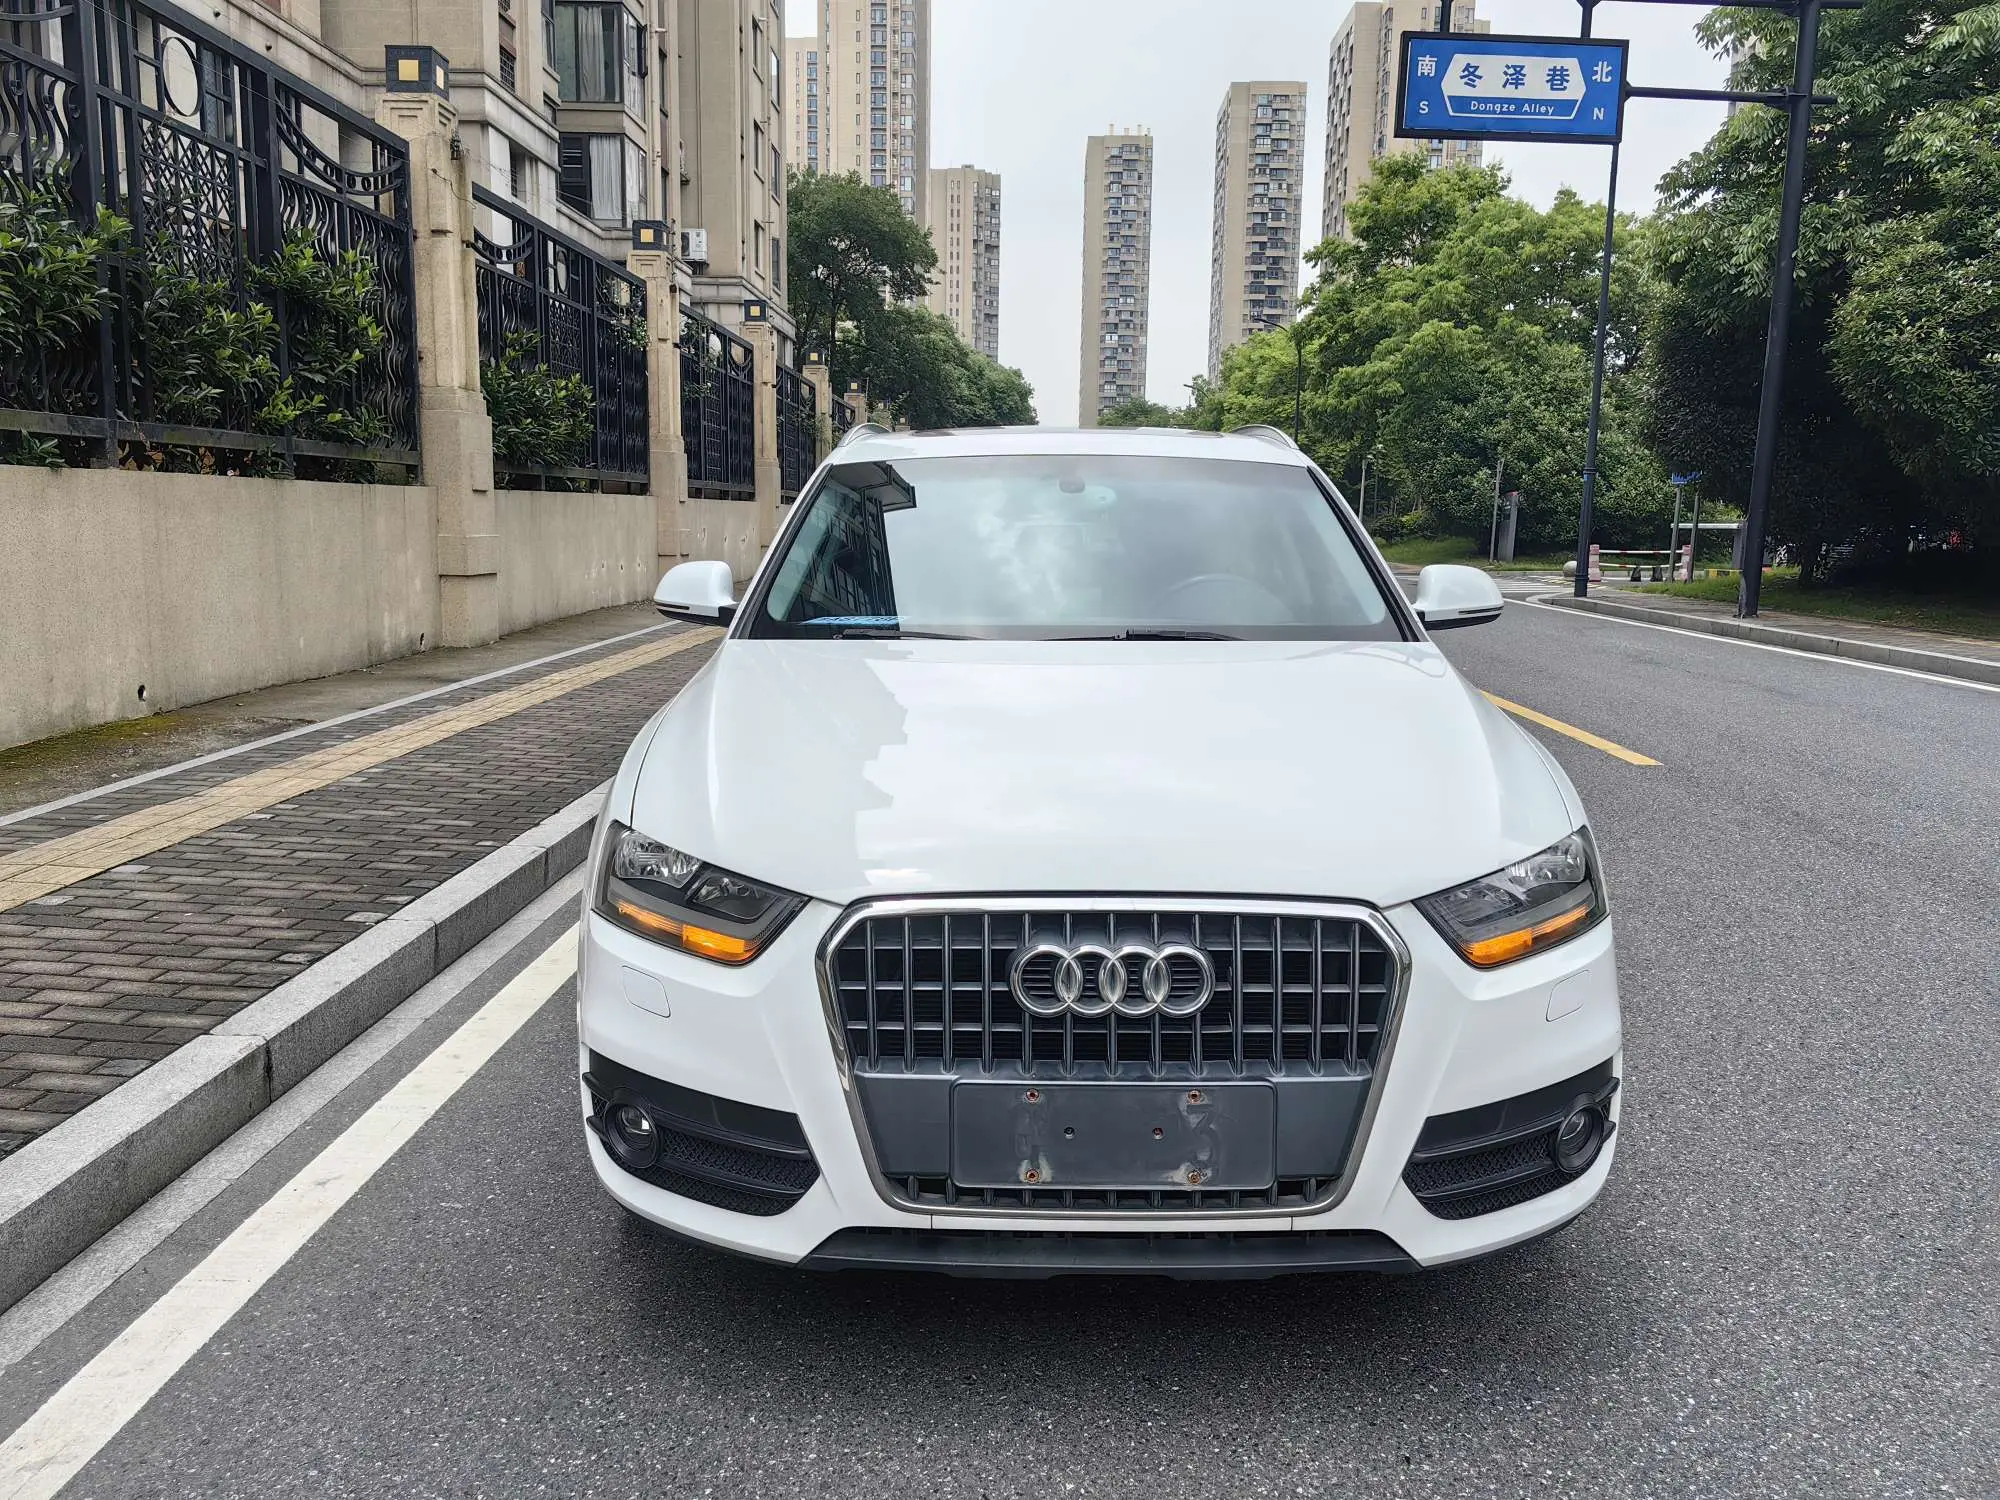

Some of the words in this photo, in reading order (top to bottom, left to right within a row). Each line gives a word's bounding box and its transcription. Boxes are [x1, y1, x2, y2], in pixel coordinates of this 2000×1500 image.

[1417, 55, 1437, 77] 南
[1592, 61, 1612, 83] 北
[1459, 62, 1570, 92] 冬泽巷
[1419, 100, 1429, 114] S
[1470, 100, 1516, 114] Dongze
[1522, 103, 1555, 116] Alley
[1593, 107, 1605, 121] N
